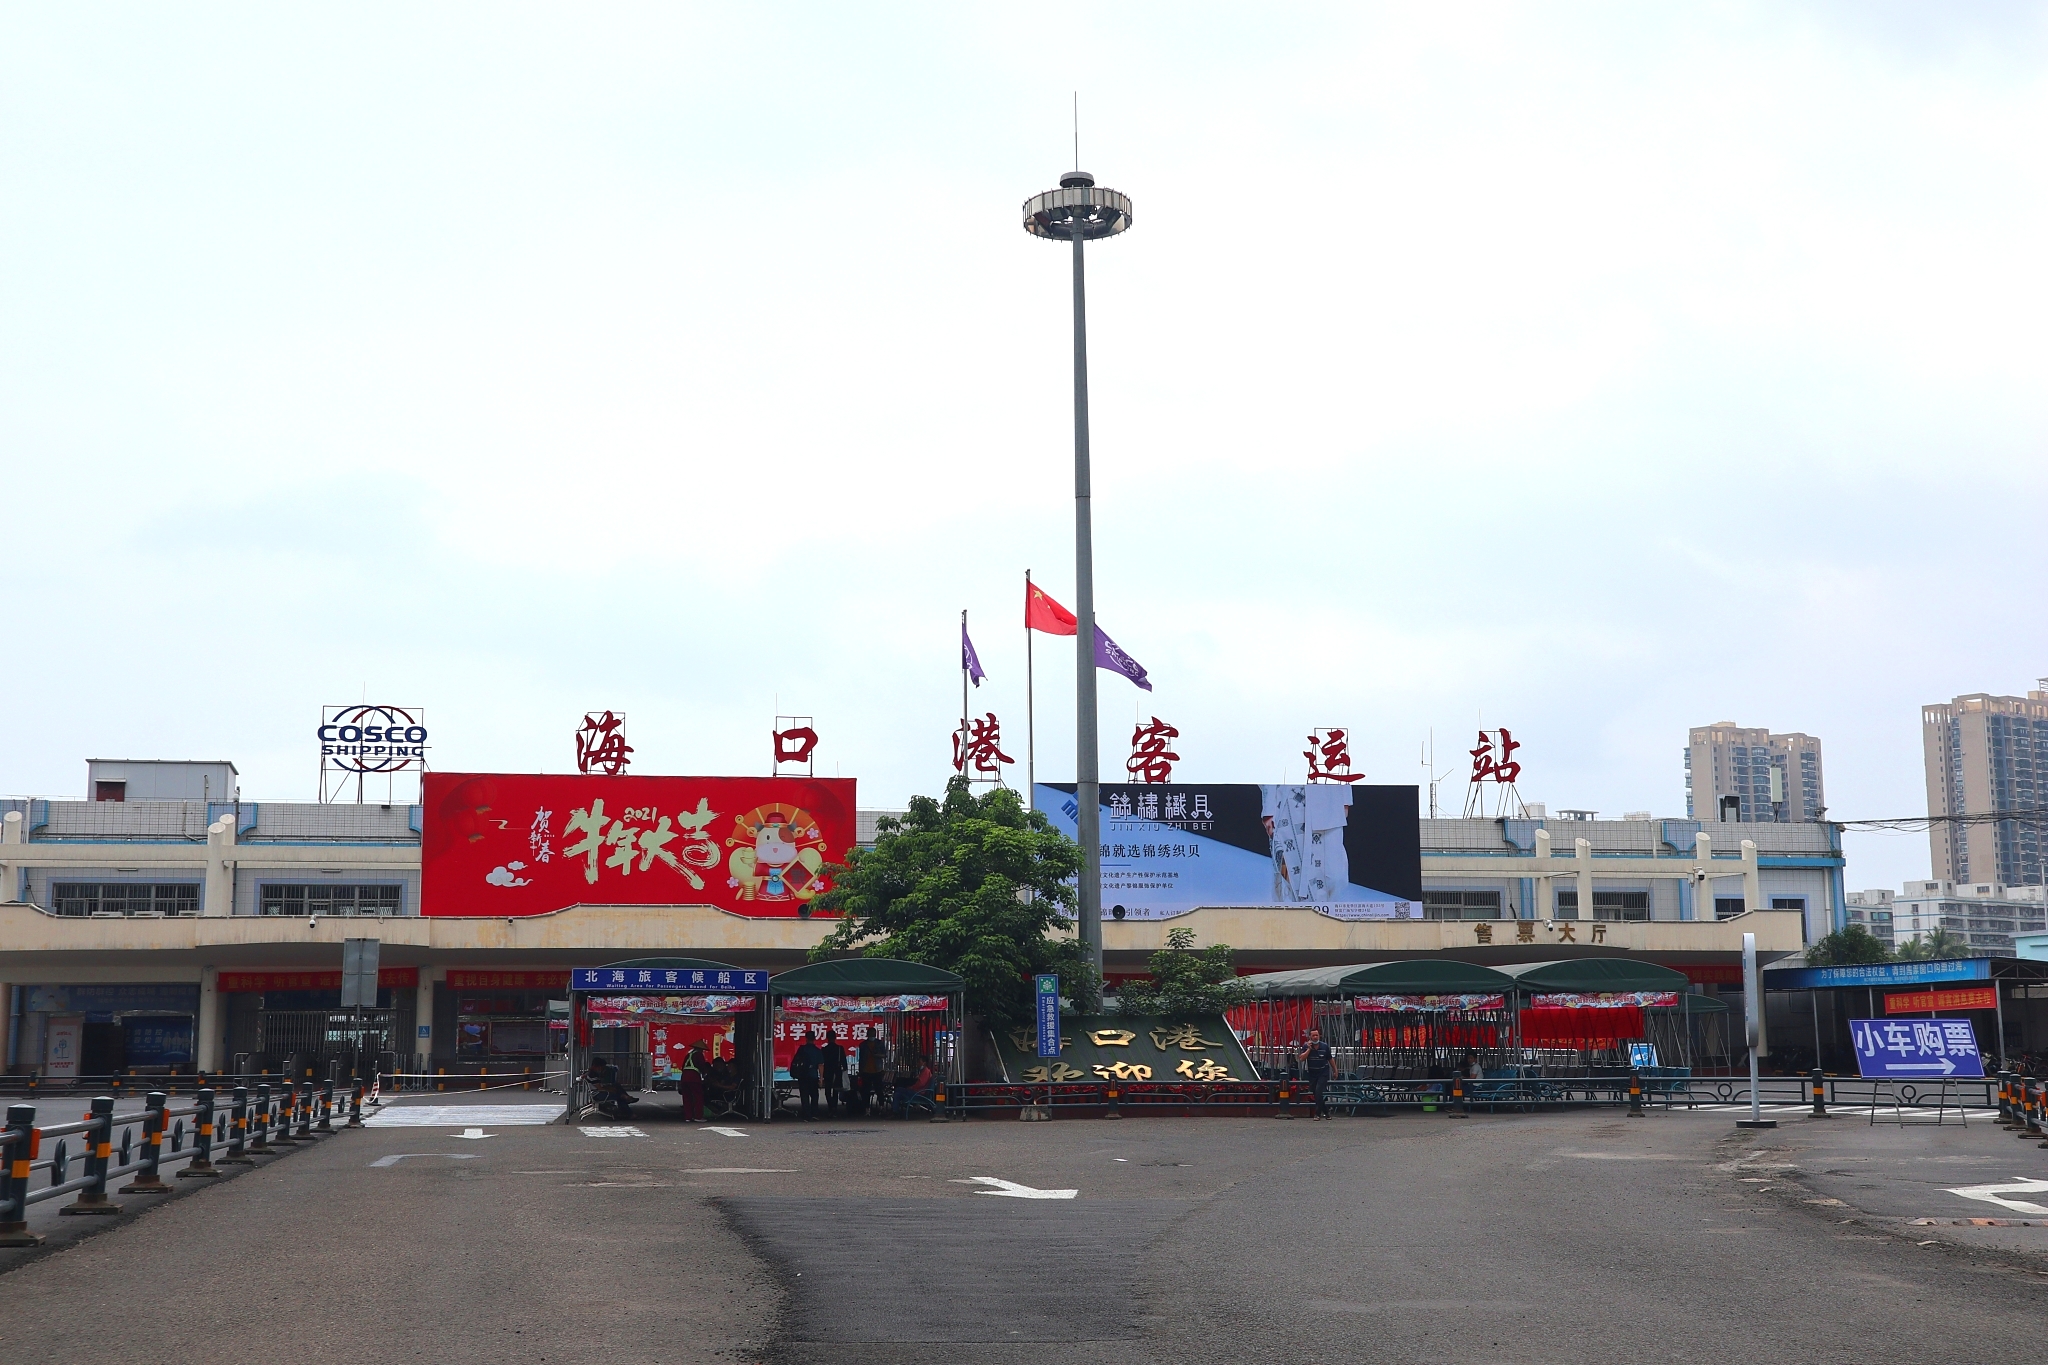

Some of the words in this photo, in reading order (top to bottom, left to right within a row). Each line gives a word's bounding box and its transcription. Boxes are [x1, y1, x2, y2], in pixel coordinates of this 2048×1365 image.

[318, 724, 428, 743] COSCO
[322, 744, 424, 757] SHIPPING
[576, 710, 1521, 784] 海口港客运站
[624, 806, 657, 823] 2021
[528, 806, 556, 864] 贺新春
[1111, 823, 1132, 832] JIN
[1139, 823, 1160, 832] XIU
[1167, 822, 1187, 831] ZHI
[1192, 822, 1212, 831] BEI
[562, 798, 724, 890] 牛年大吉
[1100, 871, 1180, 879] 文化遗产生产性保护示范基地
[1474, 921, 1607, 944] 售票大厅
[227, 975, 266, 989] 重科学
[273, 974, 312, 988] 听官宣
[454, 973, 526, 987] 重视自身健康
[585, 970, 757, 985] 北海旅客候船区
[1889, 996, 1911, 1010] 重科学
[1913, 994, 1935, 1008] 听官宣
[1046, 996, 1056, 1055] 应急救援集合点
[1857, 1021, 1978, 1058] 小车购票
